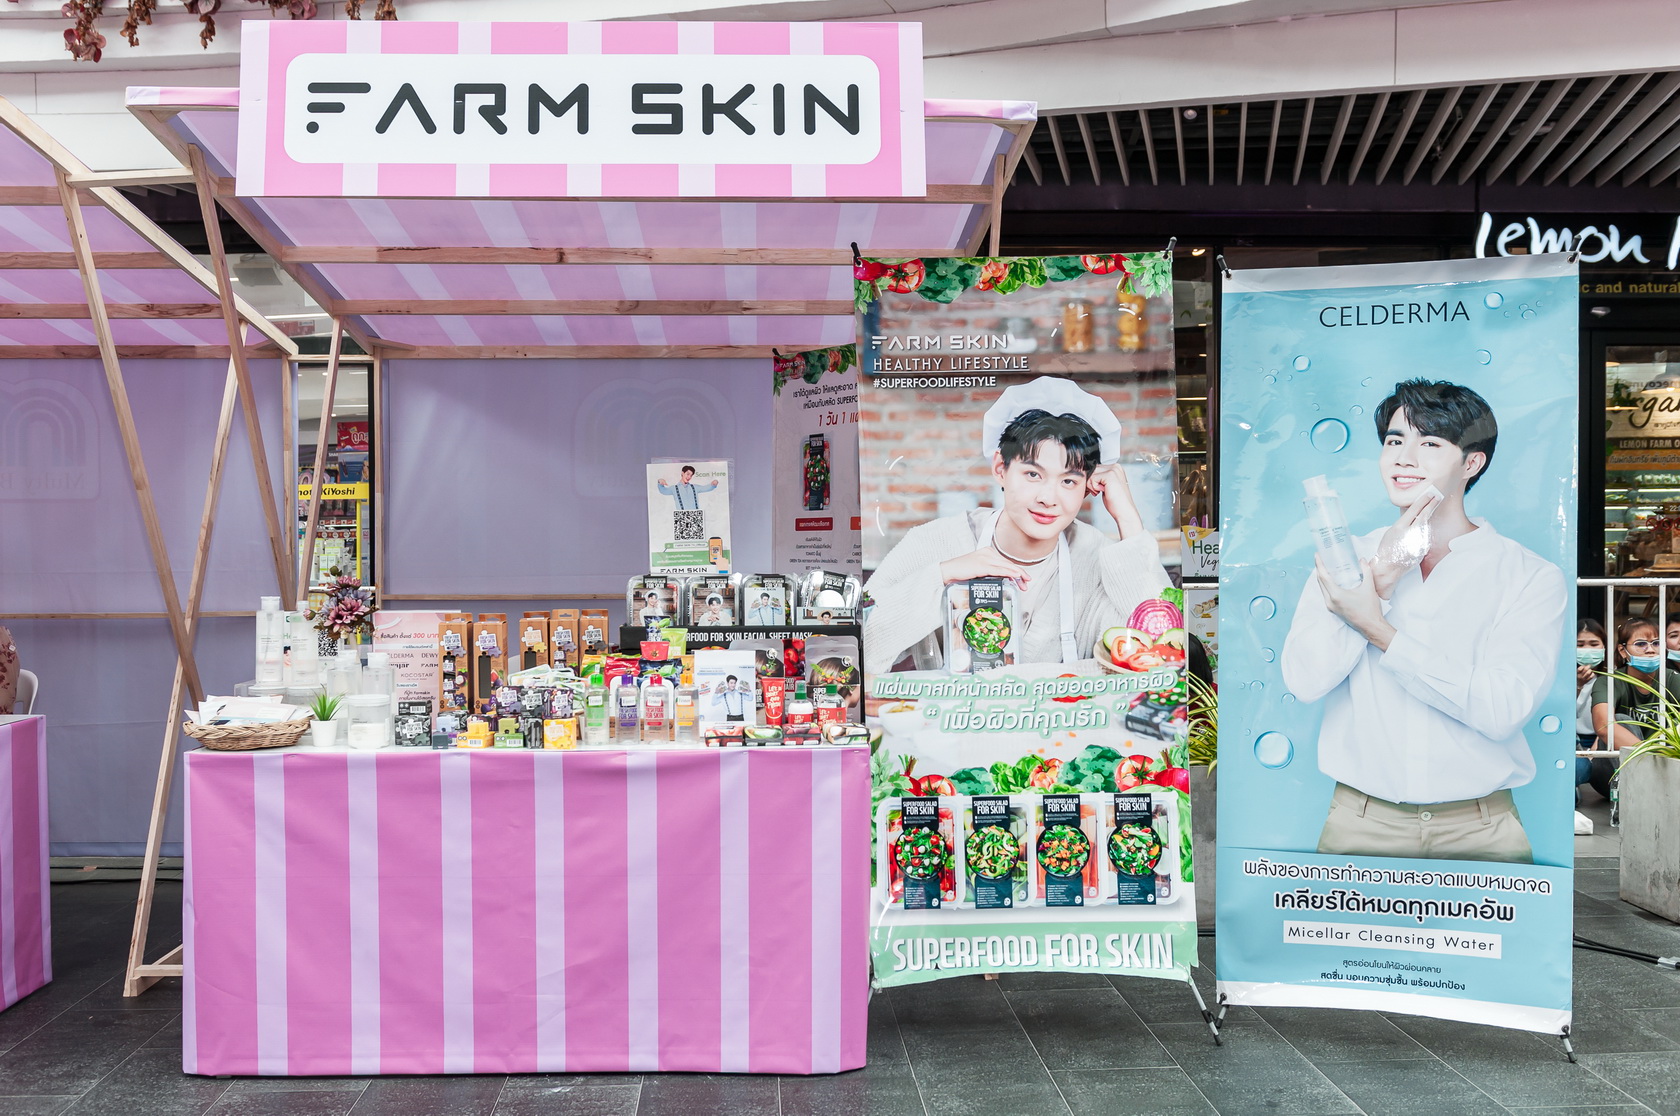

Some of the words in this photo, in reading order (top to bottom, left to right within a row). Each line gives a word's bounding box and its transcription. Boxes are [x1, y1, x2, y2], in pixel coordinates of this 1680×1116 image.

[307, 82, 589, 135] FARM
[631, 82, 860, 135] SKIN
[1475, 211, 1651, 263] lemon
[1595, 281, 1622, 293] and
[1319, 301, 1470, 327] CELDERMA
[872, 335, 941, 350] FARM
[950, 334, 1008, 349] SKIN
[873, 358, 942, 371] HEALTHY
[950, 356, 1028, 370] LIFESTYLE
[873, 376, 996, 389] #SUPERFOODLIFESTYLE
[826, 411, 839, 426] วัน
[1620, 440, 1648, 449] LEMON
[1649, 439, 1672, 449] FARM
[695, 470, 710, 478] Scan
[973, 590, 985, 599] FOR
[985, 590, 1000, 599] SKIN
[710, 632, 724, 642] FOR
[725, 631, 742, 642] SKIN
[743, 631, 766, 640] FACIAL
[769, 631, 791, 640] SHEET
[792, 631, 813, 640] MASK
[875, 674, 1026, 698] แผ่นมาสก์หน้าสลัด
[1033, 669, 1174, 704] สุดยอดอาหารผิว
[906, 807, 919, 815] FOR
[919, 807, 935, 815] SKIN
[977, 806, 990, 815] FOR
[990, 806, 1006, 815] SKIN
[1047, 803, 1059, 812] FOR
[1060, 803, 1076, 812] SKIN
[1118, 802, 1131, 811] FOR
[1131, 802, 1147, 811] SKIN
[1243, 858, 1551, 894] พลังของการทำความสะอาดแบบหมดจด
[1273, 887, 1515, 923] เคลียร์ได้หมดทุกเมคอัพ
[1288, 926, 1351, 940] Micellar
[1358, 929, 1435, 949] Cleansing
[1444, 936, 1495, 951] Water
[892, 935, 1038, 972] SUPERFOOD
[1044, 934, 1099, 967] FOR
[1105, 933, 1174, 969] SKIN
[1342, 958, 1442, 974] สูตรอ่อนโยนให้ผิวผ่อนคลาย
[1320, 968, 1344, 980] สดชื่น
